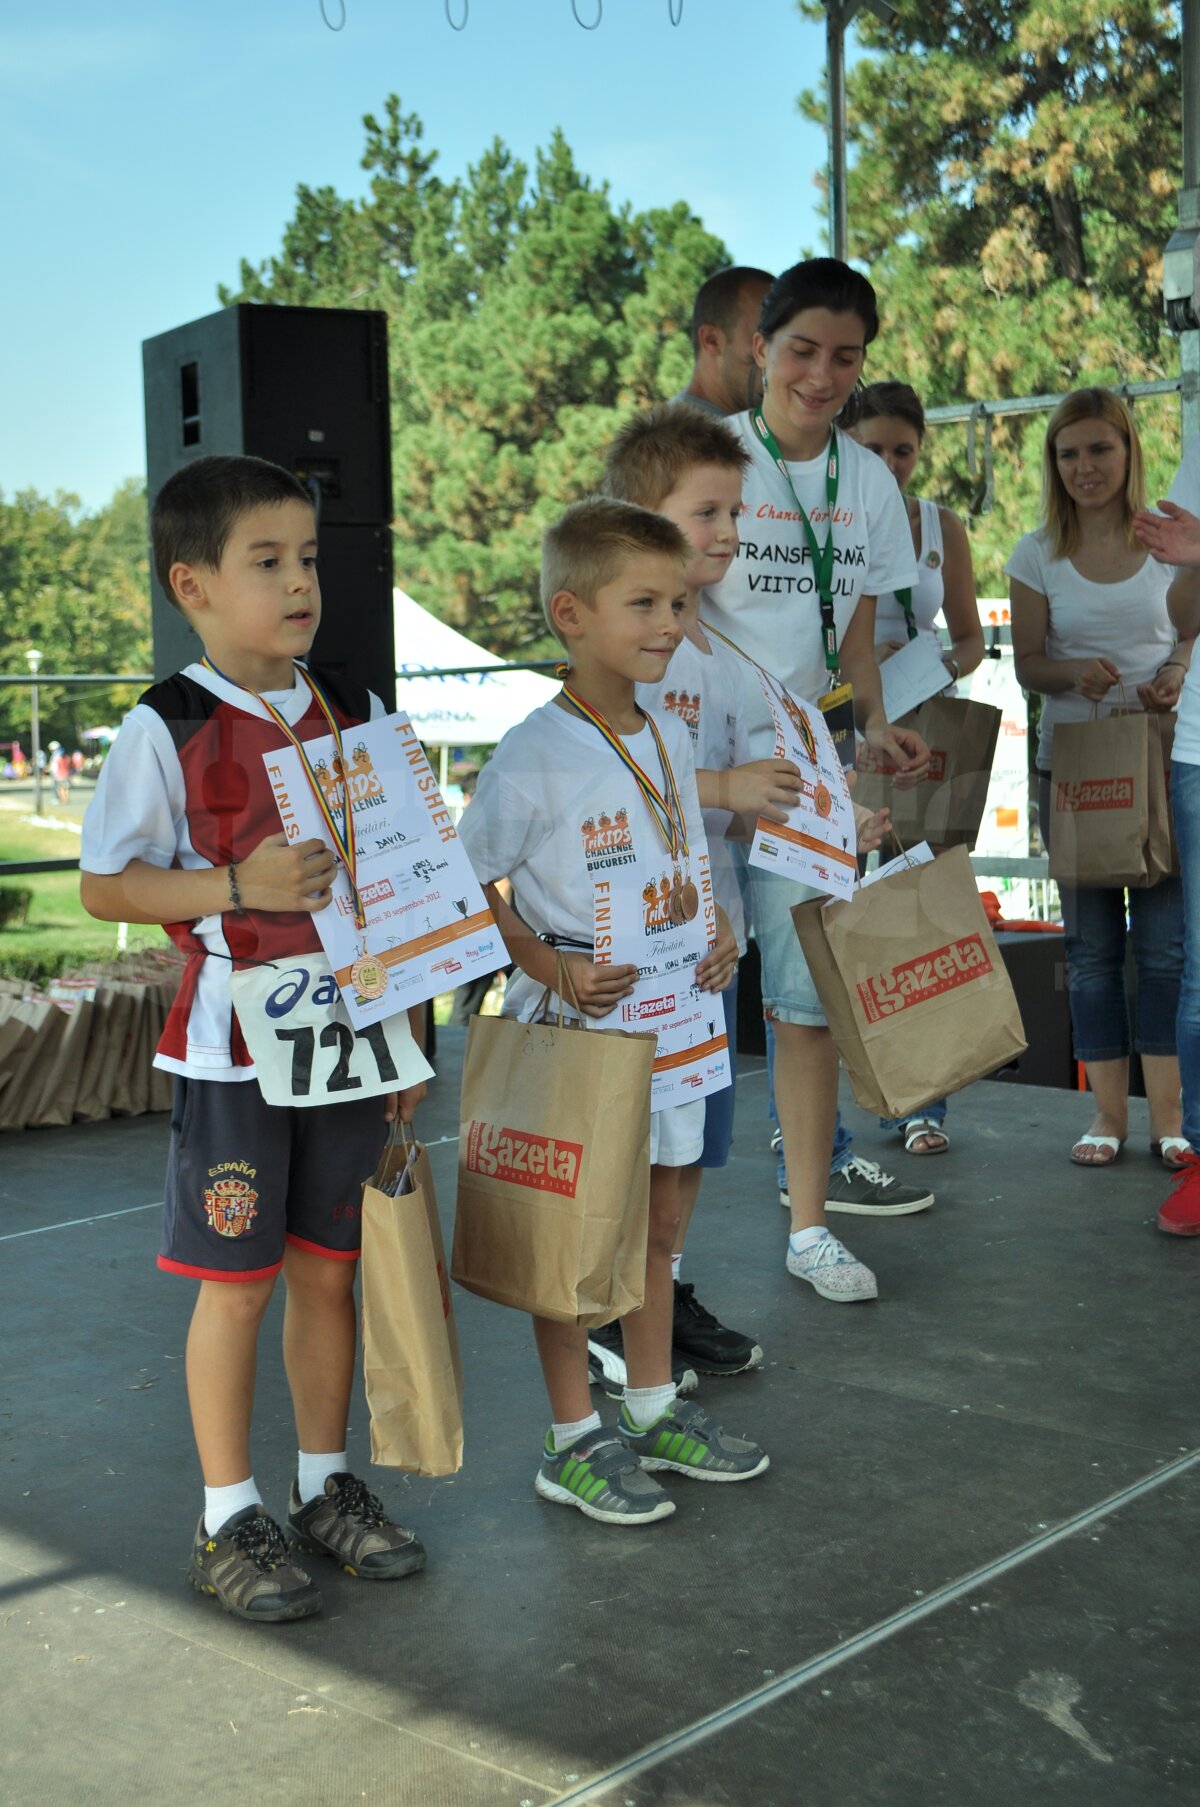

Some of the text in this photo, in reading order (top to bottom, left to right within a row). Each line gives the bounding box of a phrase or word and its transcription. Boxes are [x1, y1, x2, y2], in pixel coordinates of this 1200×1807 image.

[736, 541, 866, 566] TRANSFRMĂ
[748, 574, 854, 596] VIITOUL!
[831, 729, 848, 745] TAFF
[394, 722, 458, 844] FINISHER
[1066, 779, 1131, 811] gazeta
[268, 764, 301, 840] FINIS
[375, 831, 406, 849] DAVID
[585, 844, 634, 859] CHALLENGE
[587, 854, 637, 871] BUCURESTI
[426, 891, 440, 902] 2012
[698, 854, 718, 952] FINISHE
[594, 881, 611, 965] FINISH
[637, 965, 658, 976] OTEA
[872, 942, 986, 1014] gazeta
[628, 995, 675, 1021] gazeta
[478, 1122, 577, 1183] gazeta
[208, 1159, 257, 1179] ESPAÑA
